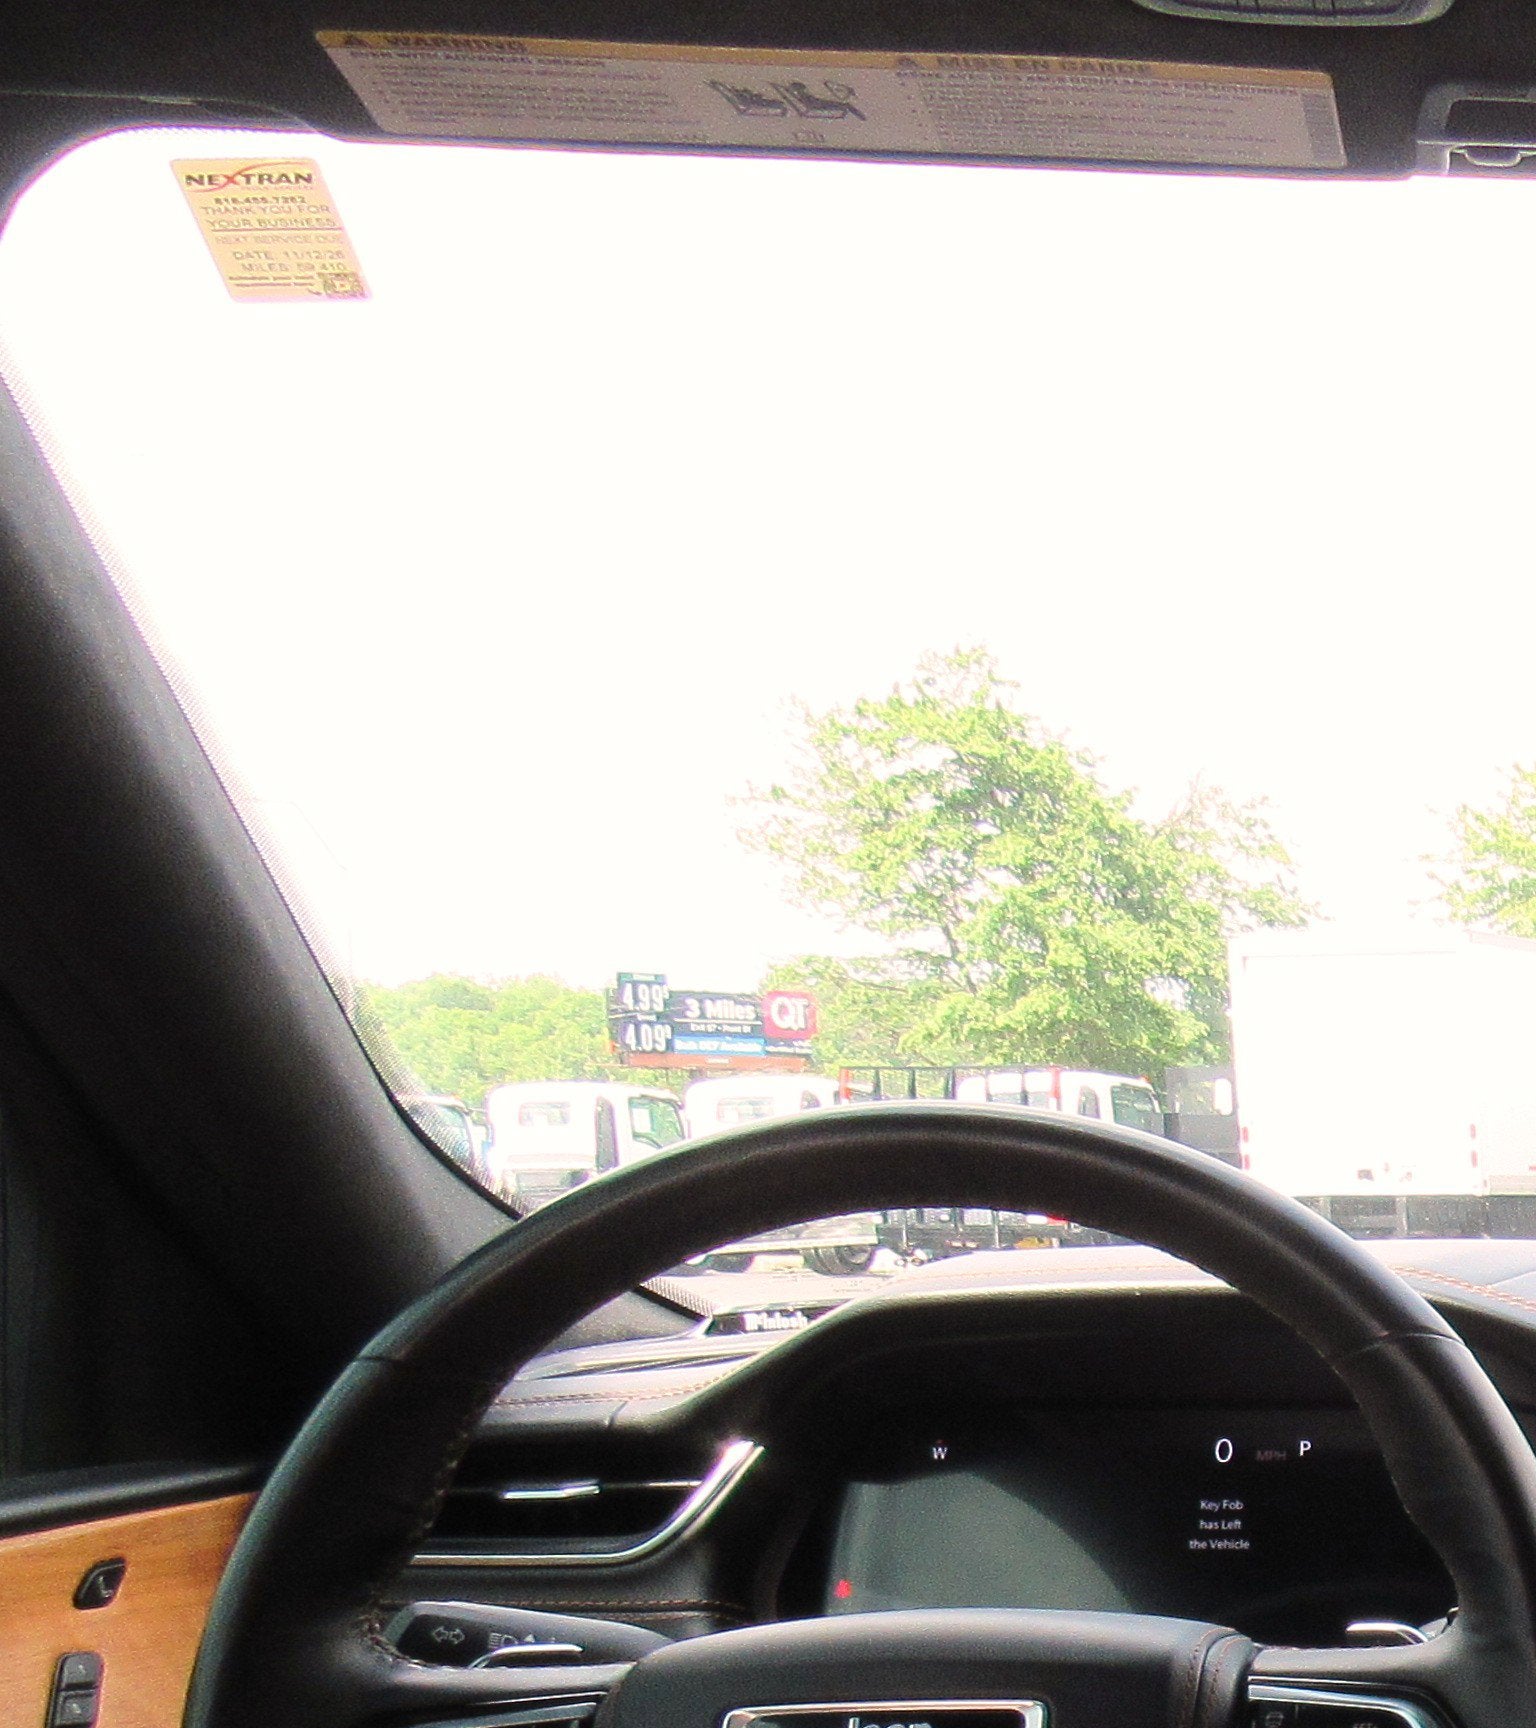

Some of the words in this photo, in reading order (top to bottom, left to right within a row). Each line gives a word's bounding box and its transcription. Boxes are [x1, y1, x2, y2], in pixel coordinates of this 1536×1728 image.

[184, 172, 314, 187] NEXTRAN
[200, 204, 257, 216] THANK
[258, 204, 293, 215] YOU
[296, 204, 332, 214] FOR
[206, 218, 253, 229] YOUR
[683, 997, 701, 1019] 3
[703, 999, 757, 1021] Miles
[769, 996, 809, 1031] QT
[933, 1446, 949, 1461] W
[1214, 1437, 1234, 1464] 0
[1299, 1439, 1313, 1457] P
[1200, 1499, 1221, 1513] Key
[1222, 1498, 1246, 1511] Fob
[1200, 1519, 1220, 1531] has
[1221, 1518, 1243, 1531] Left
[1189, 1538, 1208, 1550] the
[1209, 1538, 1251, 1551] Vehicle
